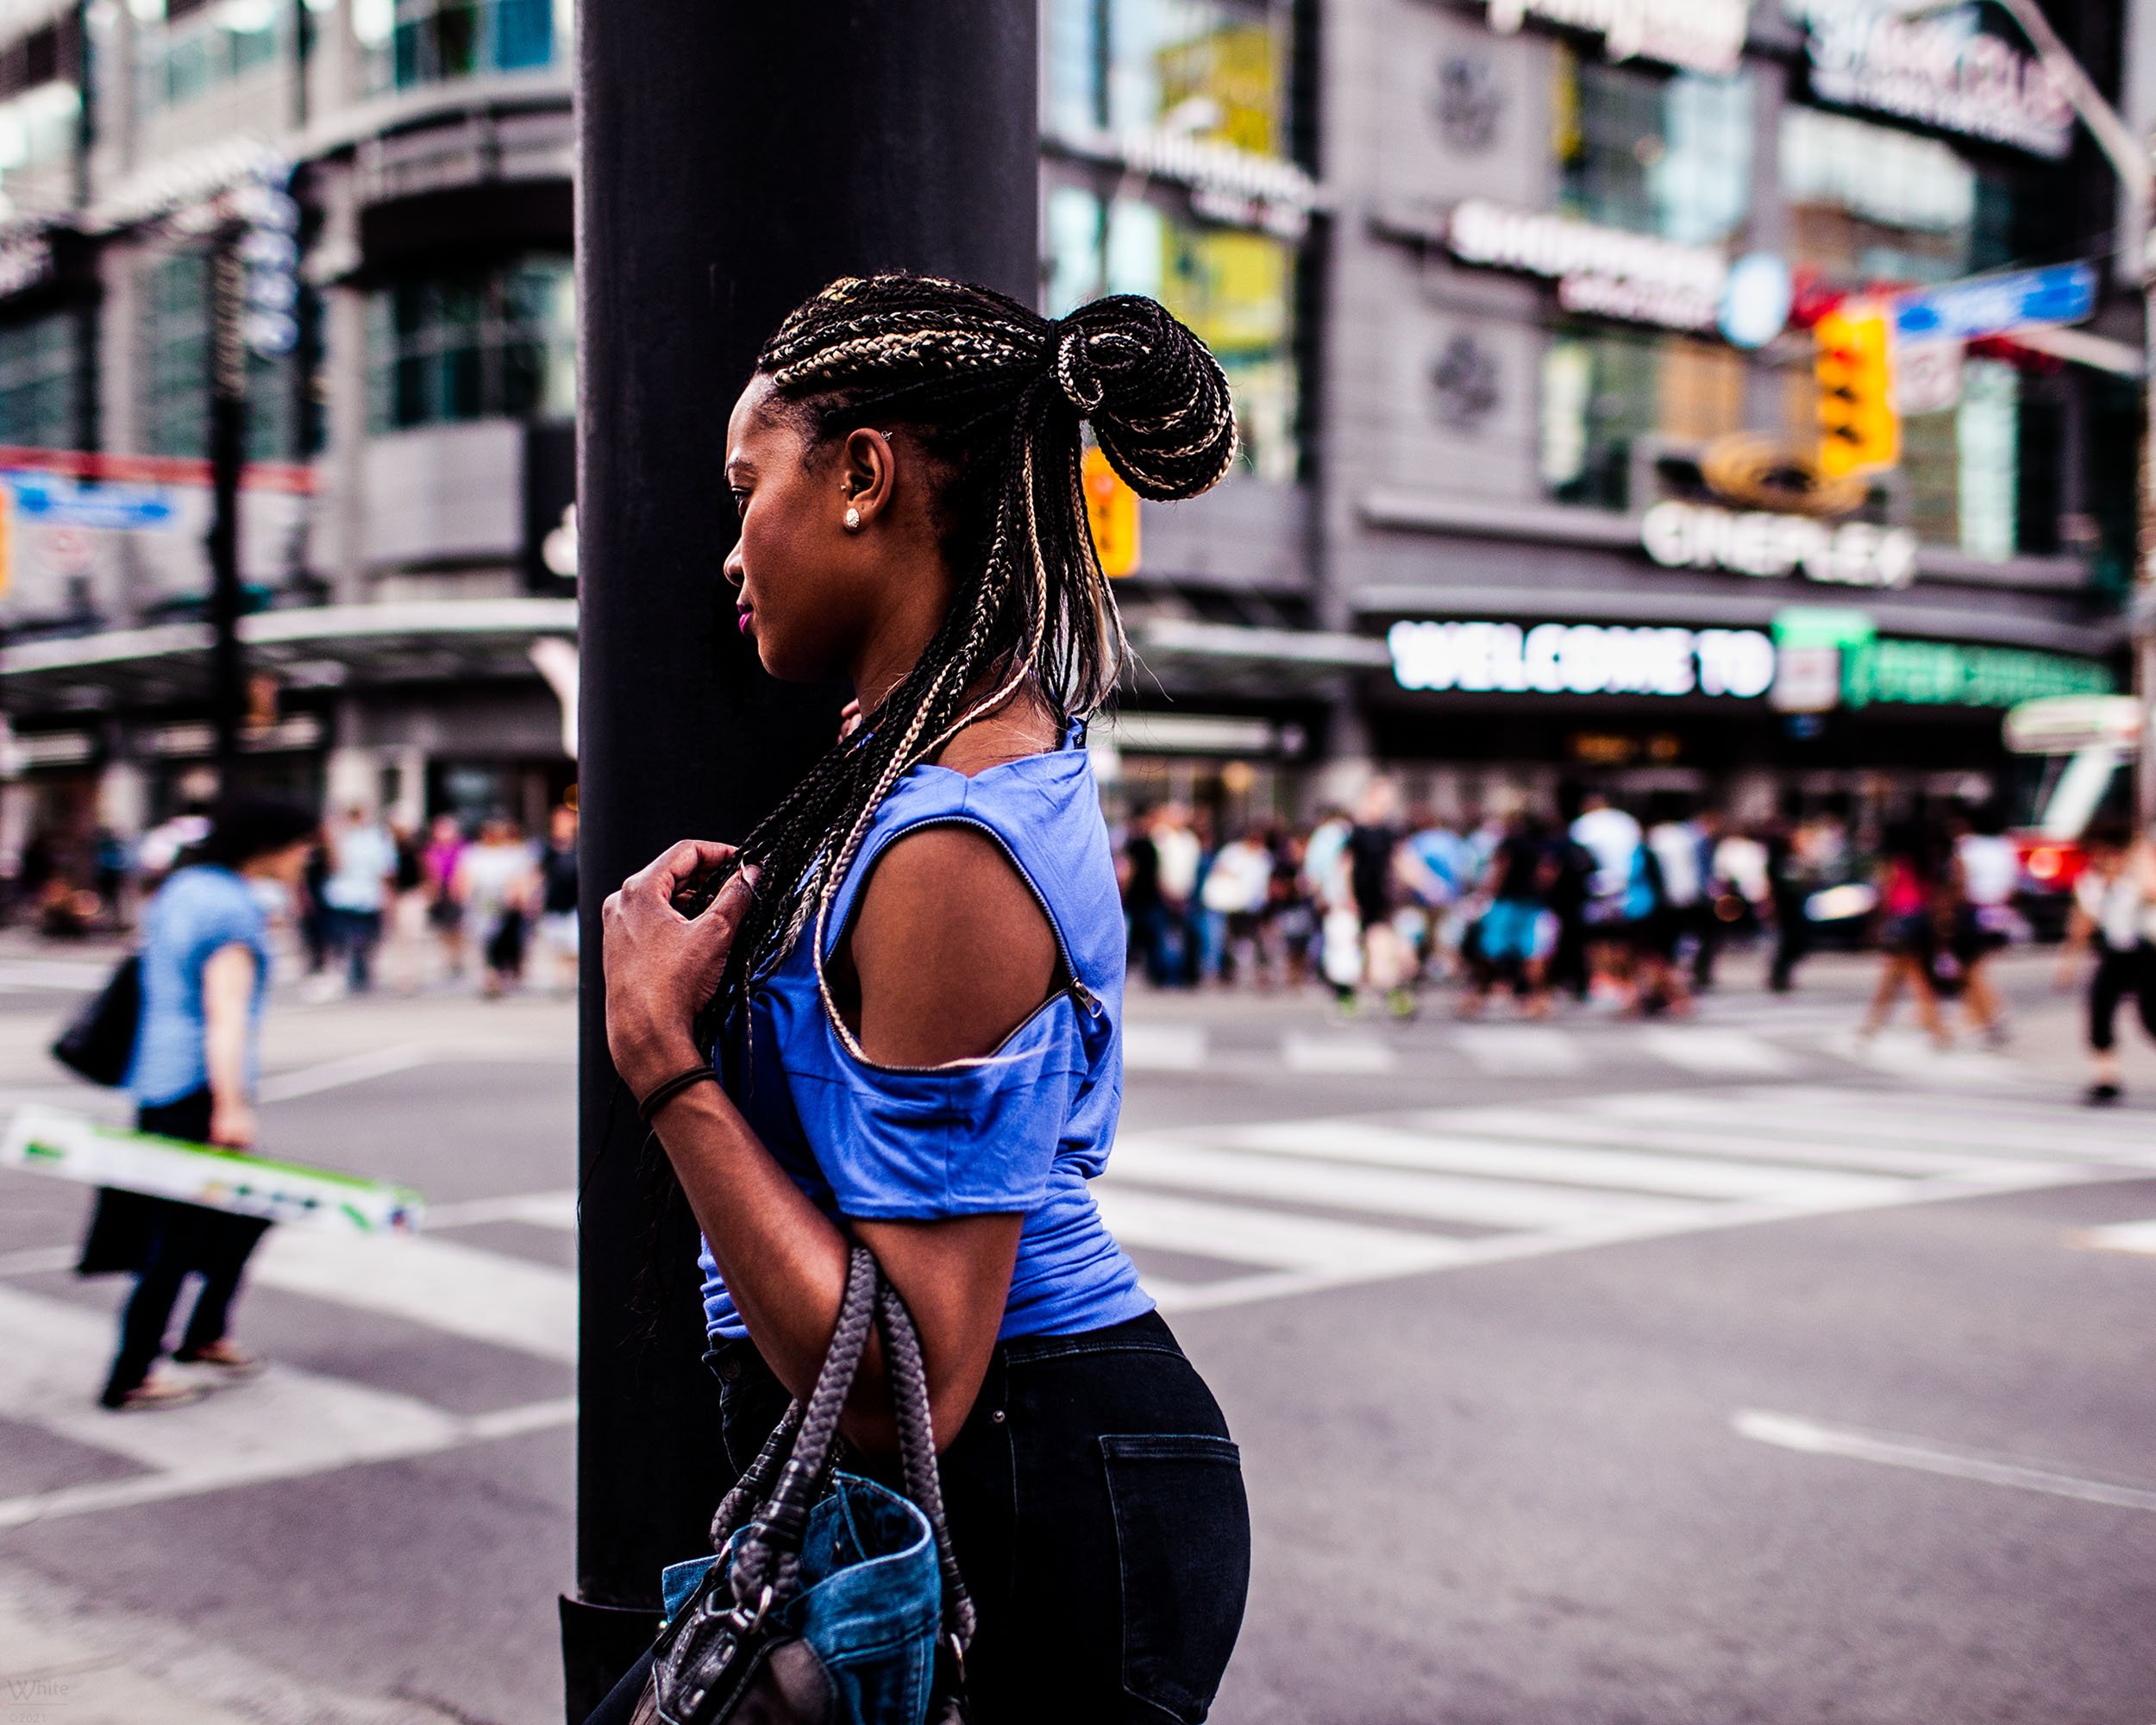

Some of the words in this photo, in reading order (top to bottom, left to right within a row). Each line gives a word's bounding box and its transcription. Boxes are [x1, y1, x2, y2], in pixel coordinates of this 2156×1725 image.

[1642, 501, 1915, 590] CINEPLEX
[1388, 620, 1695, 696] WELCOME
[1695, 628, 1775, 698] TO
